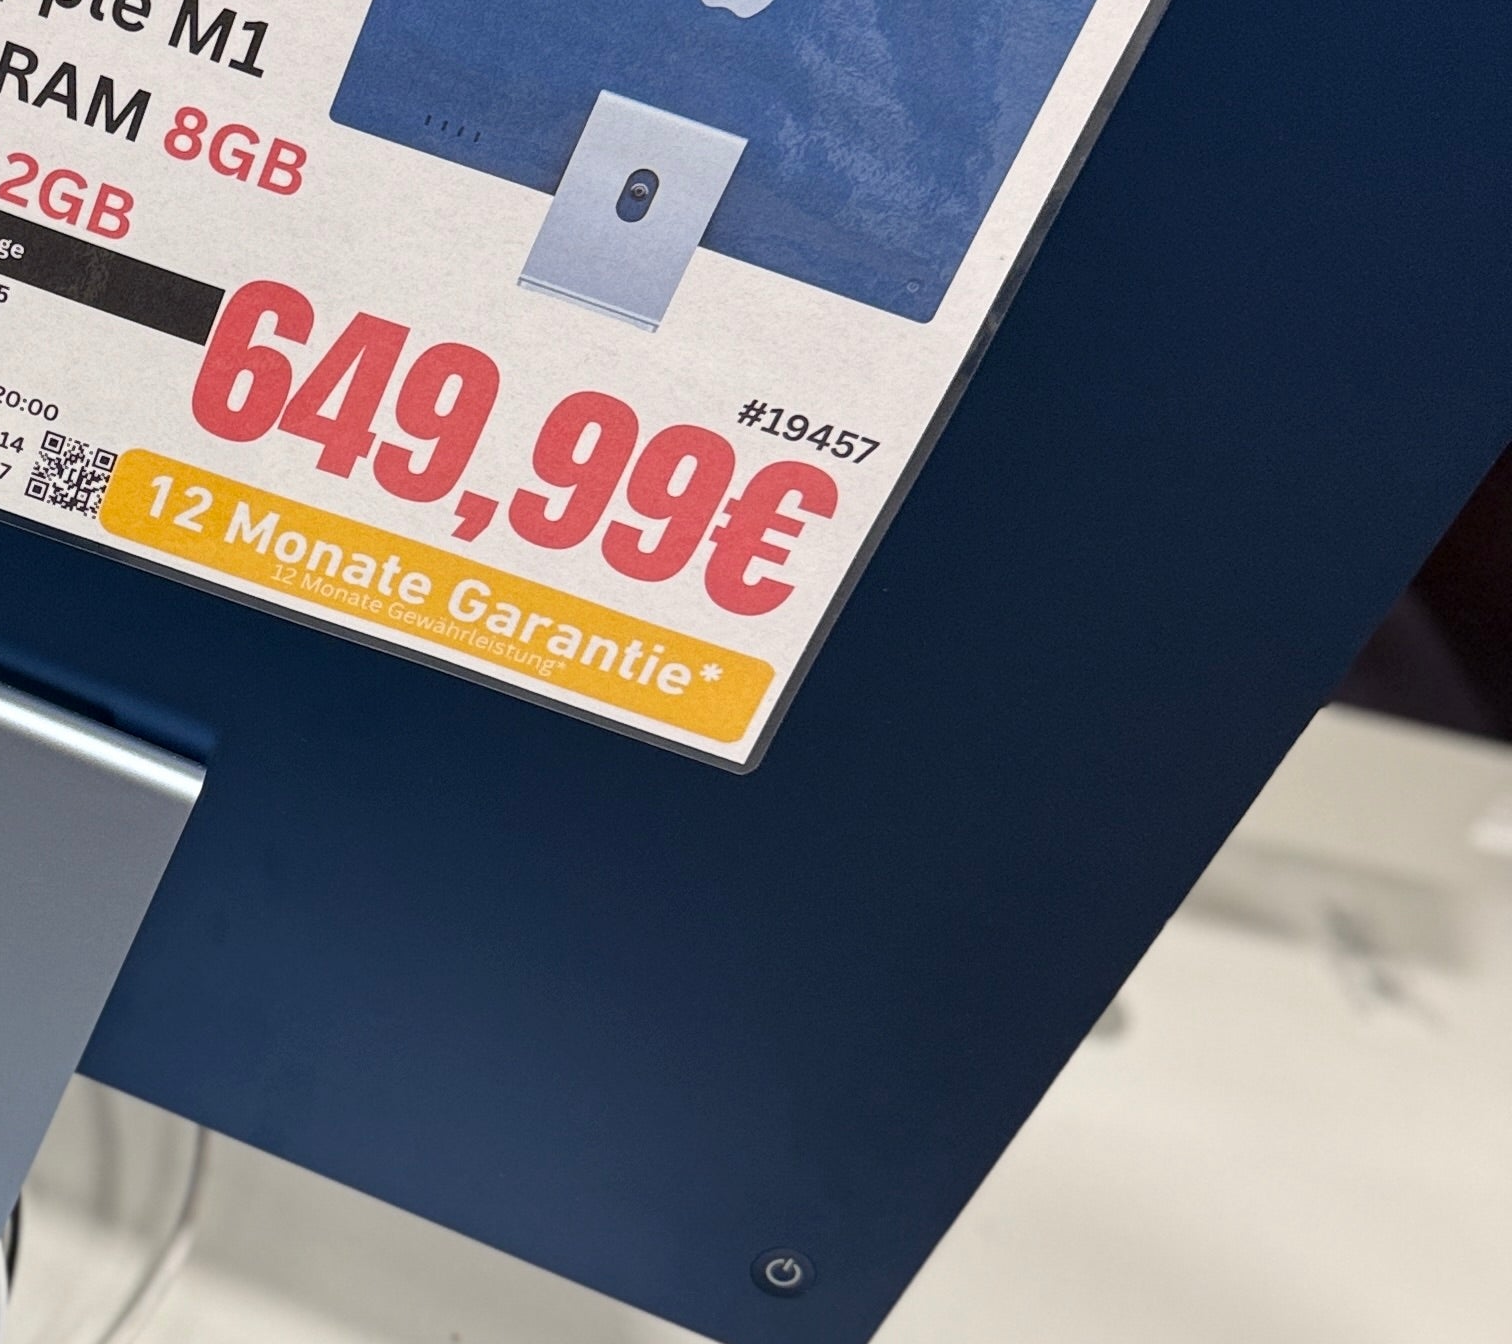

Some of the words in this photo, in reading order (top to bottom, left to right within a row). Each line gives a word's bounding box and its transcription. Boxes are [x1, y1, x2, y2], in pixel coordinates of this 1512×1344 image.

[163, 106, 307, 195] 8GB
[191, 280, 838, 616] 649,99€
[737, 399, 880, 464] #19457
[149, 475, 213, 532] 12
[224, 501, 431, 604] Monate
[271, 560, 297, 585] 12
[301, 573, 383, 613] Monate
